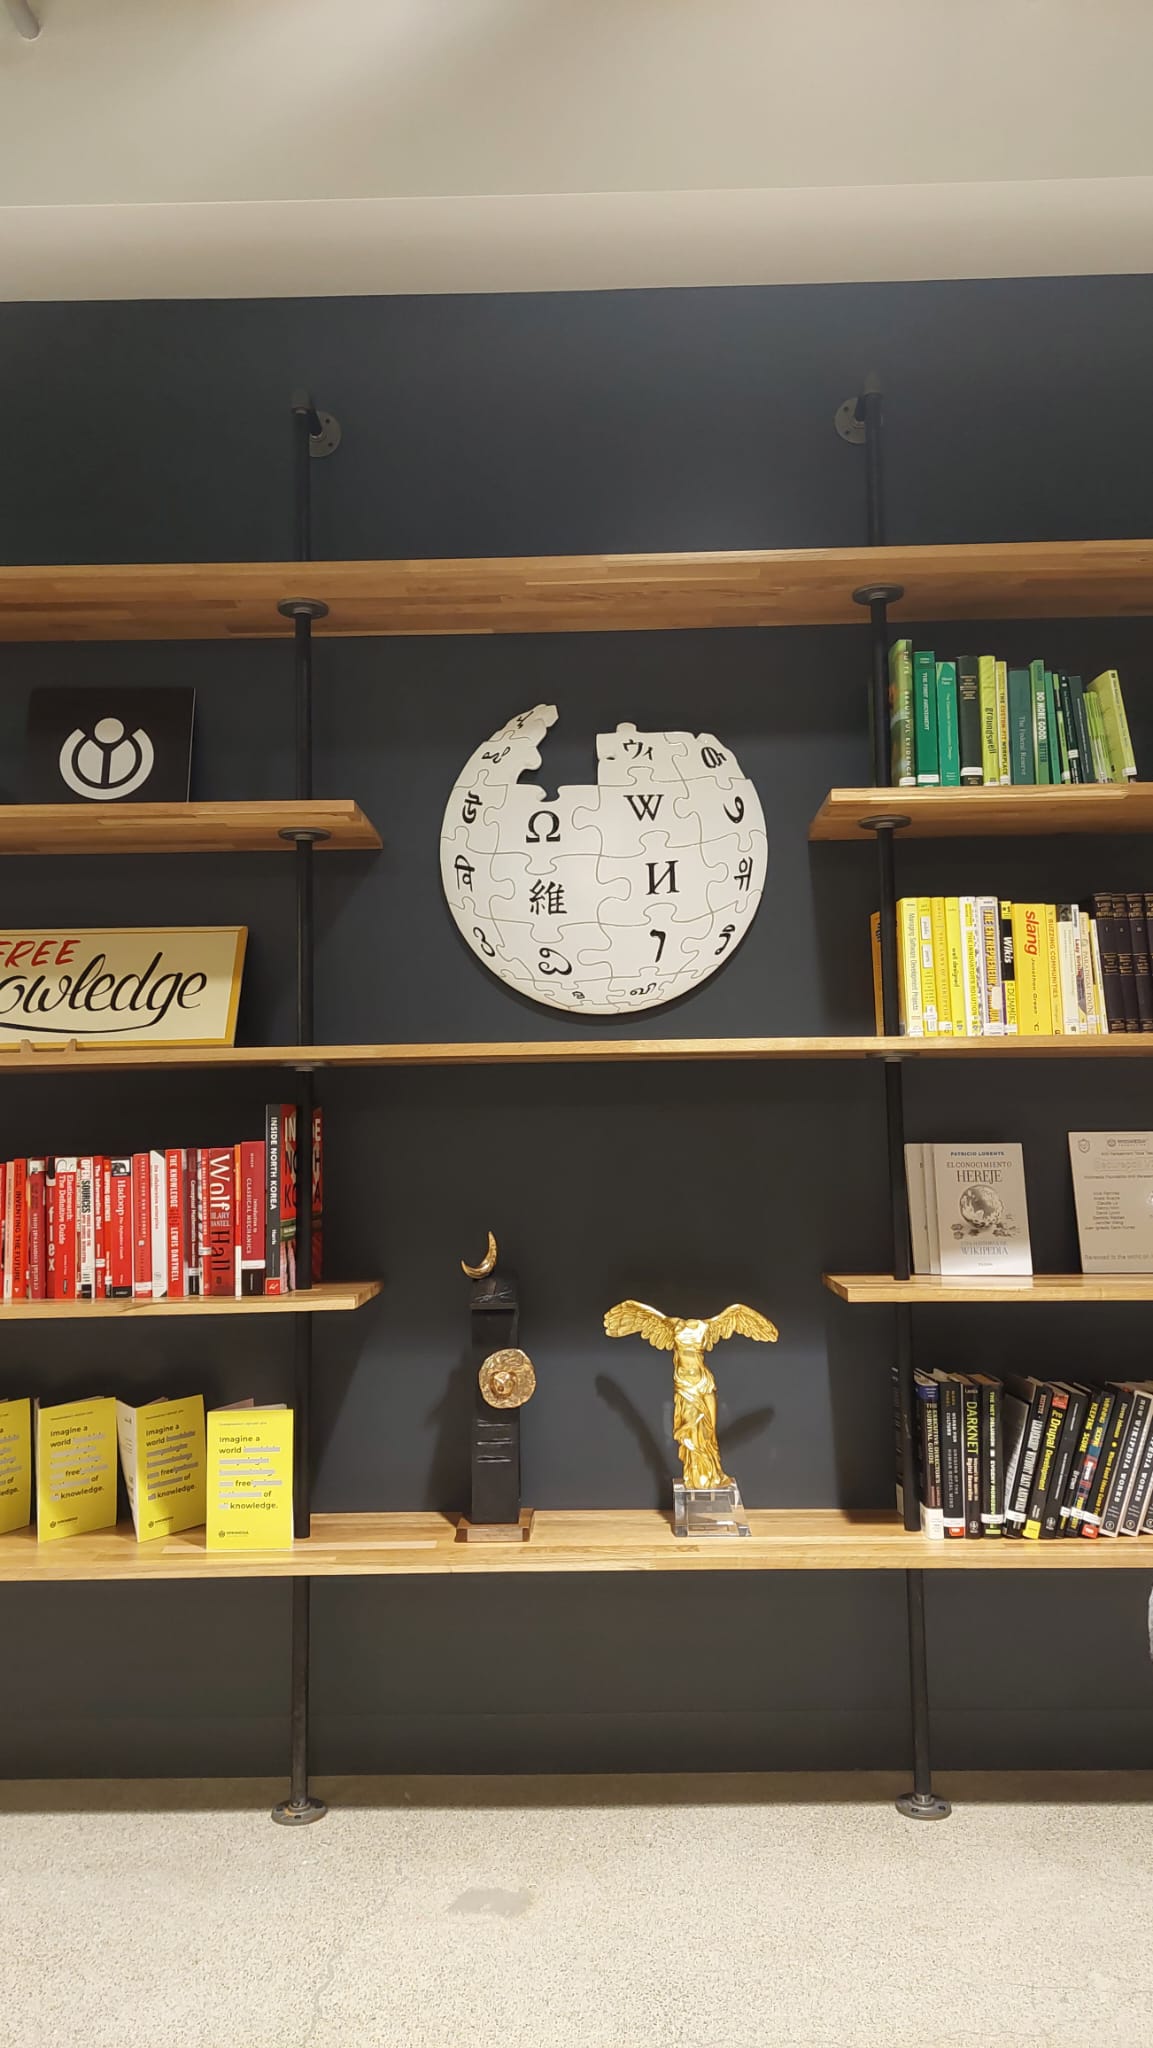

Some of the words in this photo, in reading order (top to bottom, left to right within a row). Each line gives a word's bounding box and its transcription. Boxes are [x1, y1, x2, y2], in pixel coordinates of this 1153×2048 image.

[1037, 692, 1045, 701] DO
[1018, 716, 1026, 727] The
[1037, 702, 1046, 720] MORE
[986, 708, 996, 754] groundswell
[623, 794, 664, 821] W
[526, 810, 561, 843] Ω
[645, 860, 680, 895] И
[529, 879, 567, 915] 維
[908, 913, 916, 936] Managing
[983, 910, 994, 925] THE
[1024, 911, 1039, 955] slang
[1003, 937, 1012, 963] Wikis
[911, 960, 919, 990] Development
[1050, 950, 1058, 998] COMMUNITIES
[0, 951, 208, 1034] owledge
[912, 992, 920, 1011] Projects
[170, 1155, 178, 1166] THE
[170, 1168, 178, 1208] KNOWLEDGE
[210, 1154, 230, 1211] Wolf
[957, 1170, 1002, 1183] HEREJE
[82, 1180, 91, 1213] SOURCES
[116, 1180, 125, 1215] Hadoop
[170, 1227, 179, 1247] LEWIS
[211, 1231, 230, 1270] Hall
[171, 1249, 180, 1282] DARTNELL
[967, 1401, 978, 1454] DARKNET
[1084, 1402, 1098, 1430] KEEPING
[50, 1426, 81, 1437] Imagine
[50, 1439, 72, 1448] world
[145, 1425, 174, 1437] Imagine
[146, 1437, 165, 1447] world
[219, 1436, 252, 1444] Imagine
[1027, 1420, 1043, 1451] LEADERSHIP
[1045, 1418, 1061, 1449] Drupal
[1078, 1432, 1090, 1453] SCORE
[1122, 1419, 1141, 1469] WIKIPEDIA
[184, 1473, 191, 1481] of
[1038, 1449, 1053, 1490] Development
[1069, 1470, 1079, 1490] Brown
[1114, 1473, 1128, 1502] WORKS
[230, 1502, 278, 1510] knowledge.
